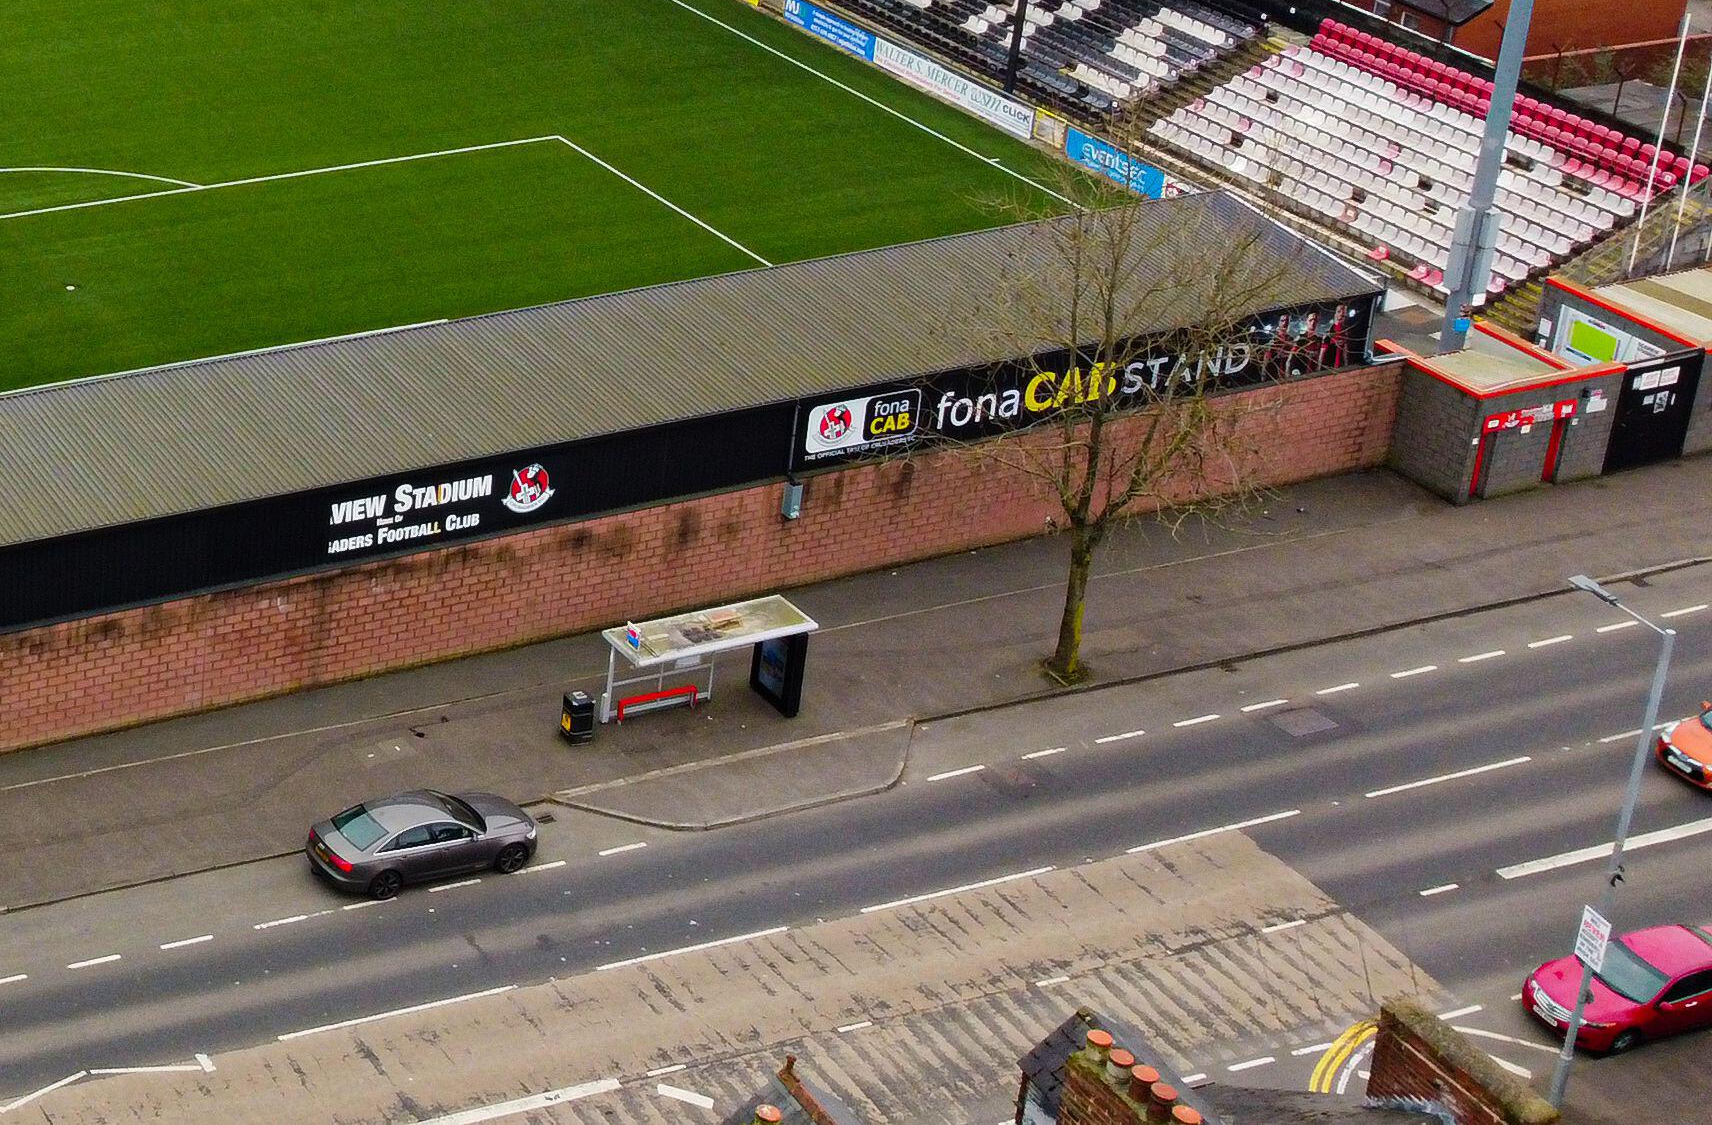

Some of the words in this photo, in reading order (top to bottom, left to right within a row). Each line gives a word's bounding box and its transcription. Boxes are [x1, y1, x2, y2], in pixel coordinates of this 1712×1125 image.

[1003, 104, 1031, 125] CLICK
[1121, 341, 1252, 395] STAND
[874, 398, 910, 418] fona
[869, 412, 911, 435] CAB
[816, 449, 846, 461] OFFICIAL
